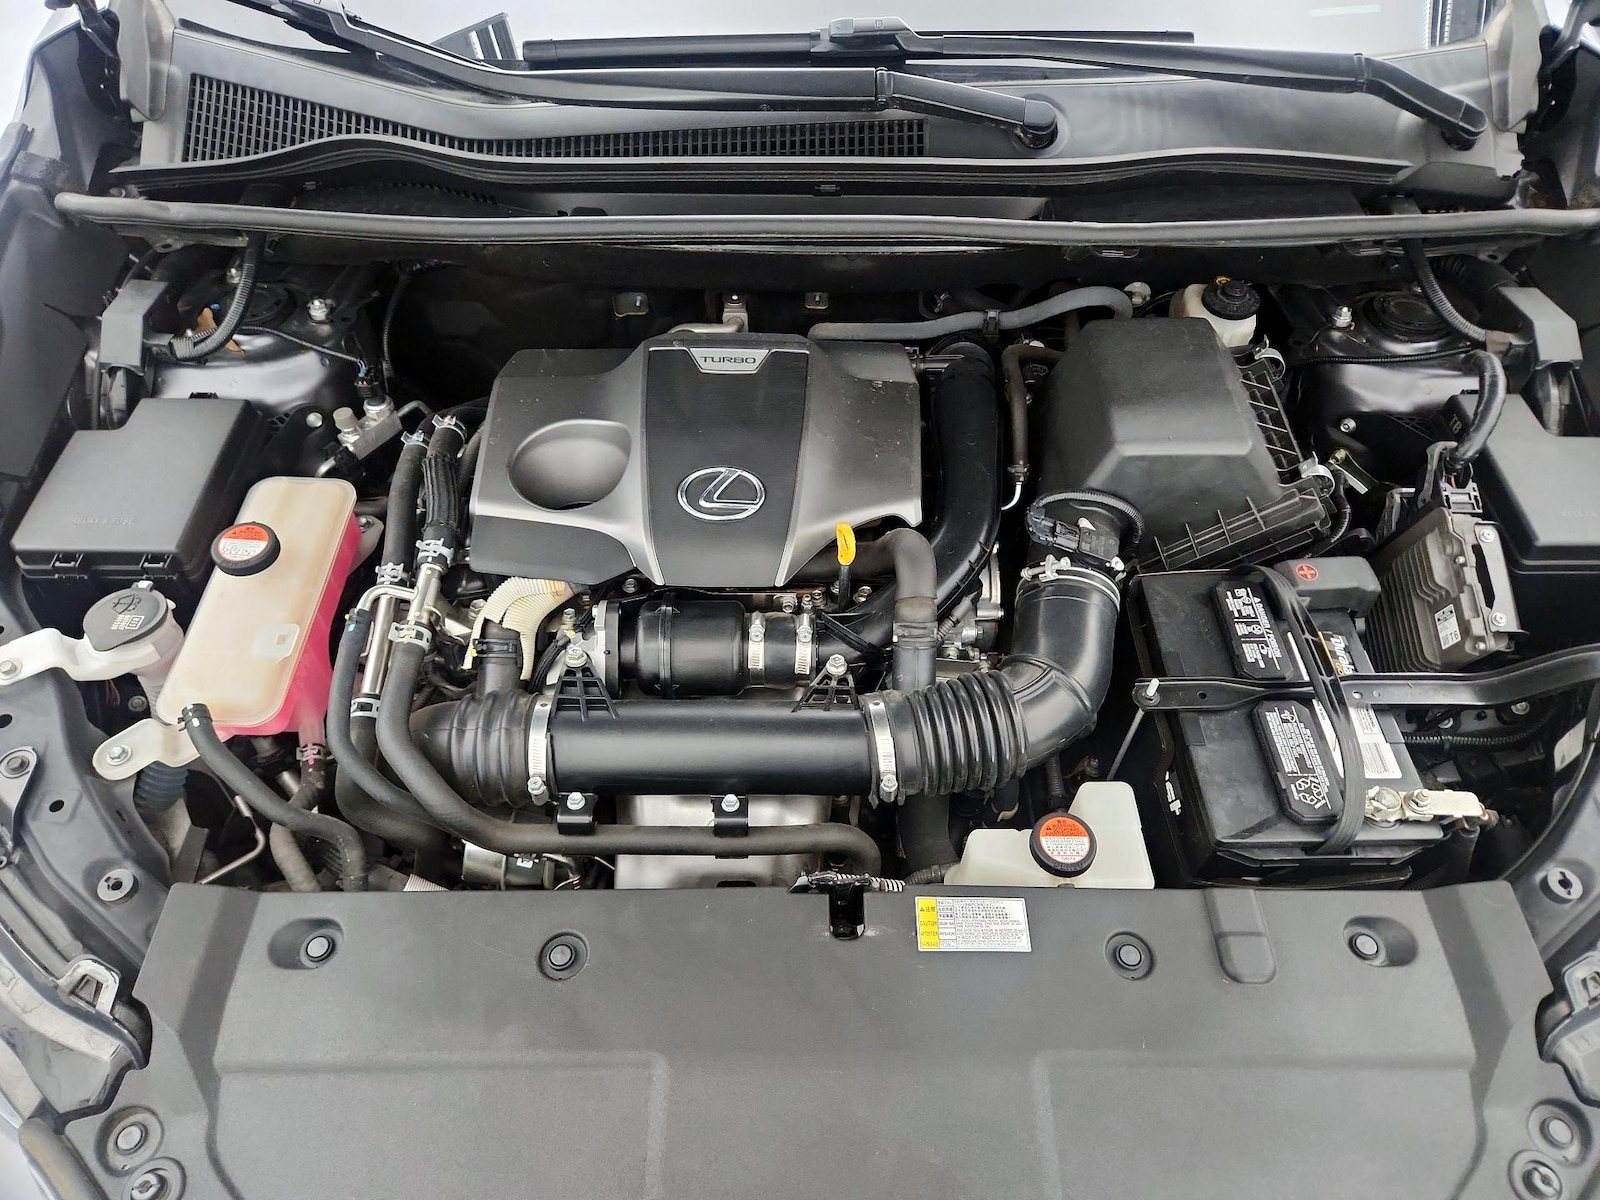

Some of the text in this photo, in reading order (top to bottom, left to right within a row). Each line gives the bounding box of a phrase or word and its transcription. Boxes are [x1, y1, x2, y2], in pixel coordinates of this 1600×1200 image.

[700, 356, 757, 364] TURBO
[1255, 602, 1271, 628] DANGER
[1267, 633, 1283, 658] POISON
